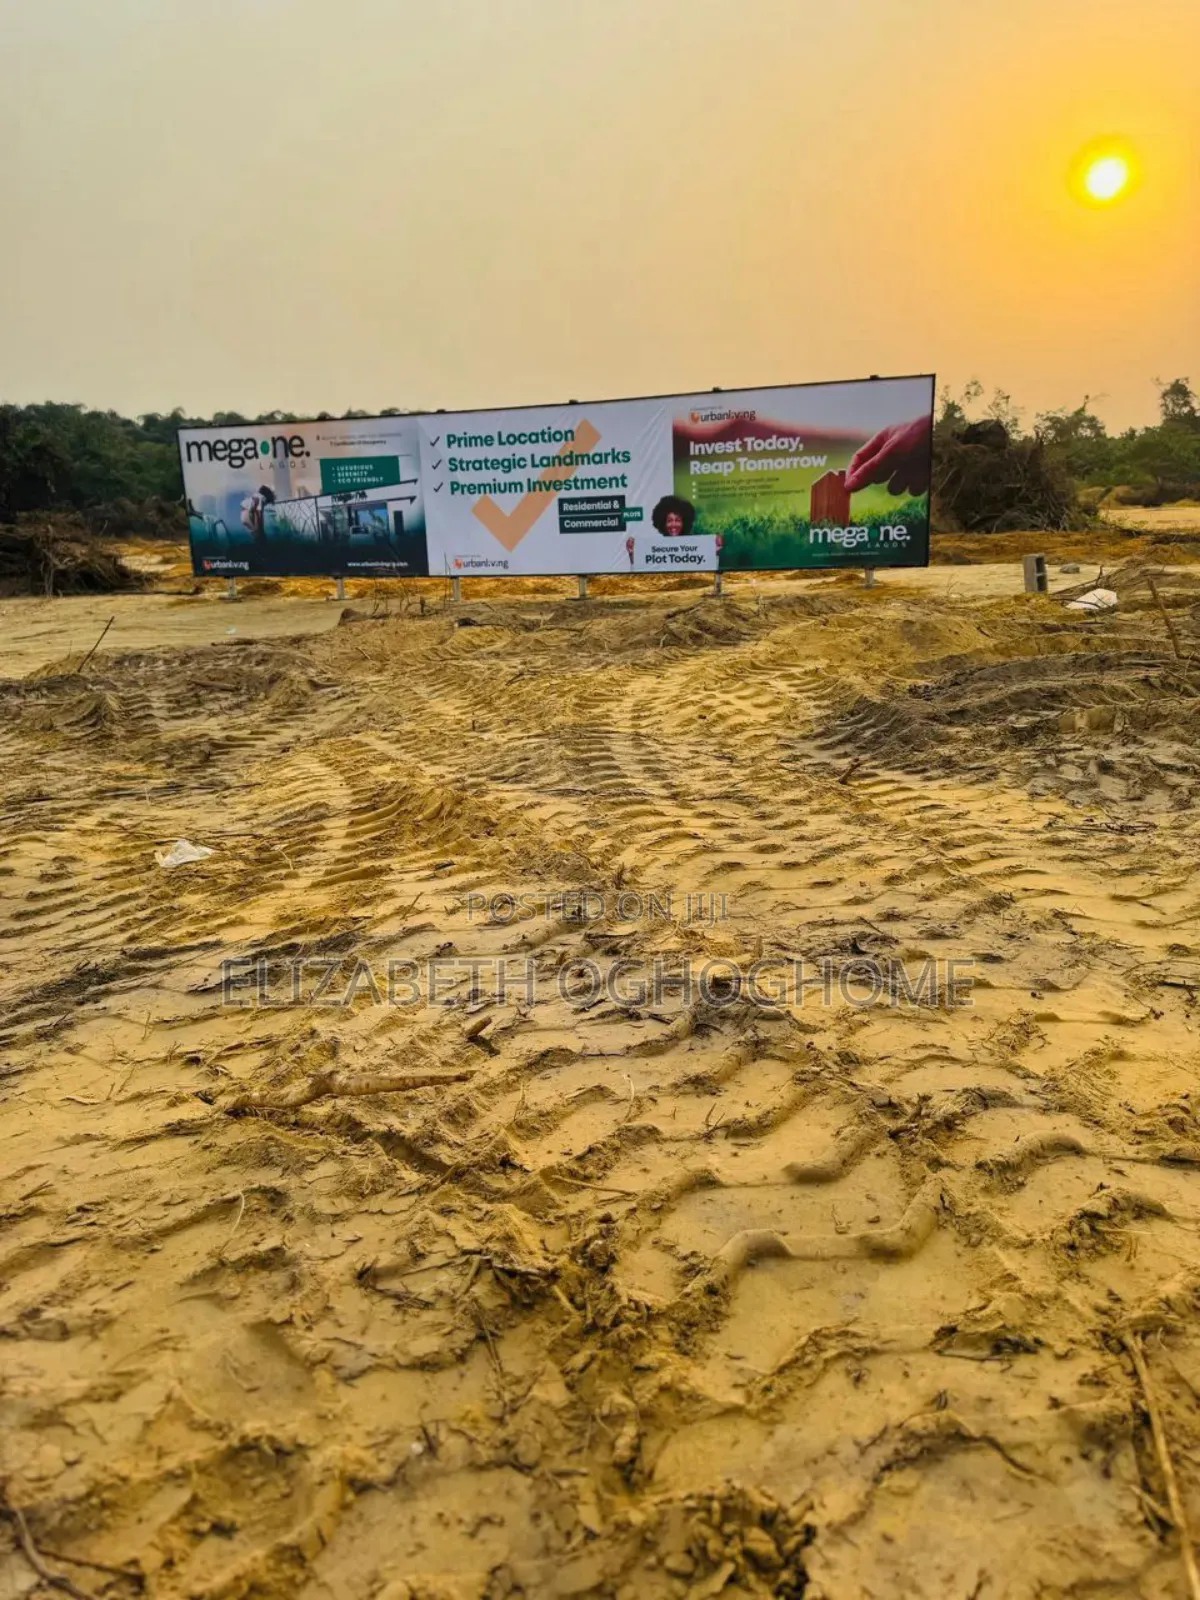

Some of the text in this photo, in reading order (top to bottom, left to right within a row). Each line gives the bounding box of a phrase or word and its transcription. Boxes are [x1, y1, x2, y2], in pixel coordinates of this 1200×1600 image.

[447, 426, 575, 449] Prime Location
[689, 434, 804, 456] Invest Today,
[259, 460, 307, 470] LAGOS
[448, 448, 631, 474] Strategic Landmarks
[690, 455, 826, 476] Reap Tomorrow
[352, 475, 385, 483] FRIENDLY
[450, 473, 628, 496] Premium Investment
[562, 500, 620, 512] Residential &
[623, 510, 641, 518] PLOTS
[564, 517, 619, 529] Commercial
[651, 544, 698, 554] Secure Your
[867, 541, 907, 549] LAGOS
[645, 552, 706, 565] Plot Today.
